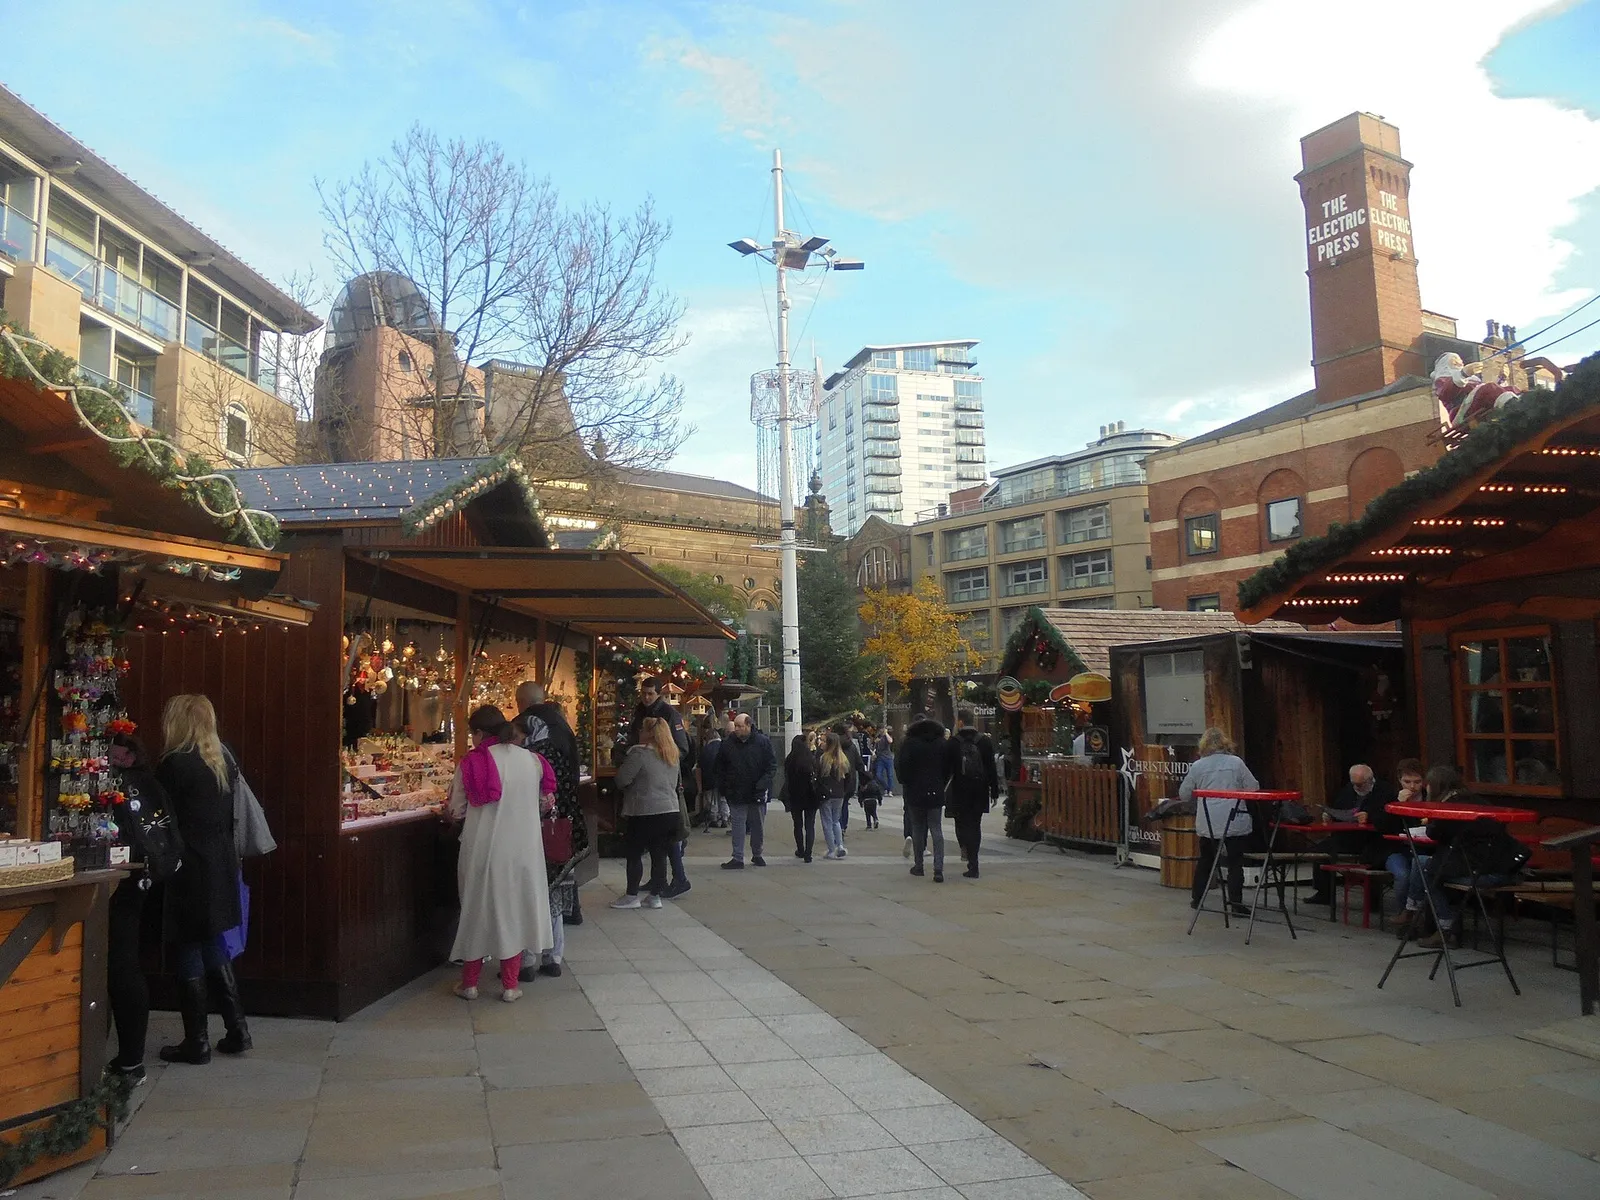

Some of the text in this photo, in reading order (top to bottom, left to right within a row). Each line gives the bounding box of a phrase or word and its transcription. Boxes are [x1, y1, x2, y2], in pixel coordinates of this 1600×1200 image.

[1322, 194, 1348, 218] THE
[1379, 190, 1398, 211] THE
[1308, 208, 1366, 245] ELECTRIC
[1370, 207, 1411, 235] ELECTRIC
[1317, 231, 1360, 262] PRESS
[1377, 229, 1408, 254] PRESS
